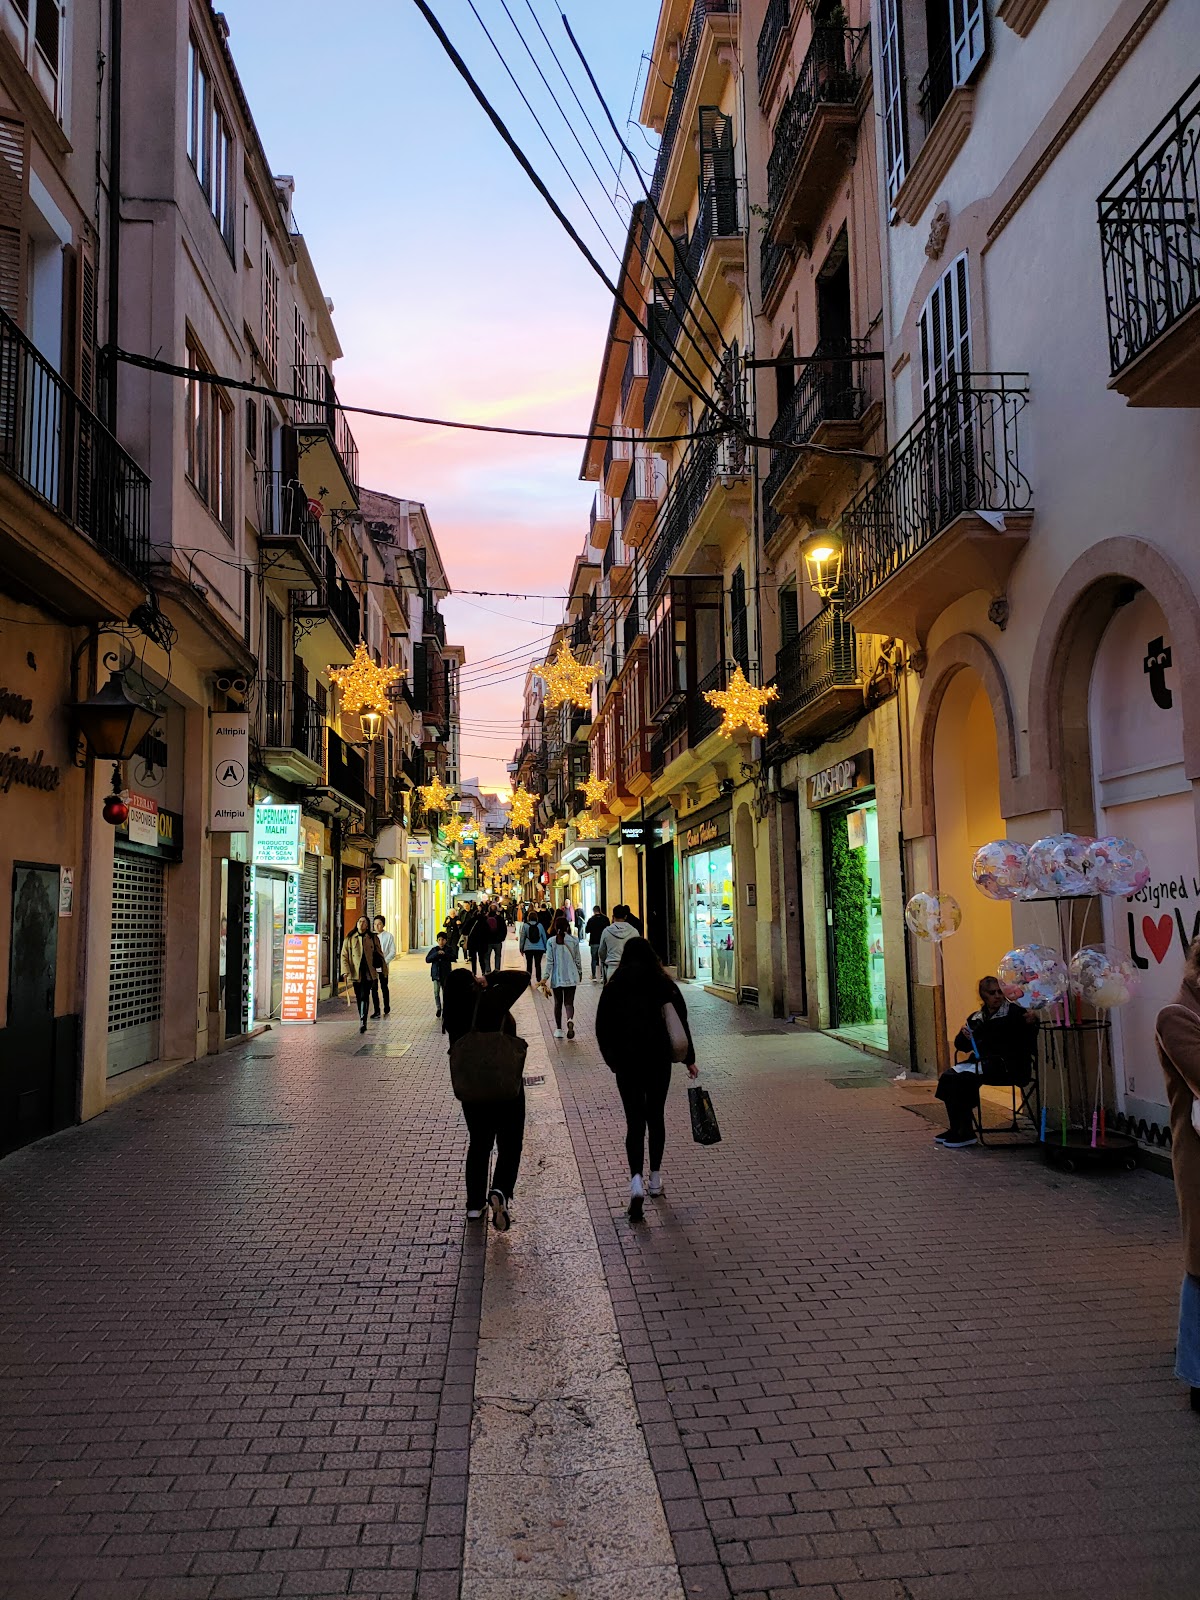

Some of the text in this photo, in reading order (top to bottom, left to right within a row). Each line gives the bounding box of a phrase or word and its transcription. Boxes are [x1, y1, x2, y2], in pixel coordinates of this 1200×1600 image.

[216, 727, 246, 737] Altripiu
[811, 760, 855, 802] ZAPSHOP
[130, 809, 156, 828] DISPONIBLE
[214, 809, 245, 819] Altripiu
[256, 809, 298, 824] SUPERMARKET
[265, 826, 287, 834] MALHI
[242, 866, 250, 1033] SUPERMARKET
[305, 936, 317, 1018] SUPERMARKET
[285, 982, 304, 994] FAX
